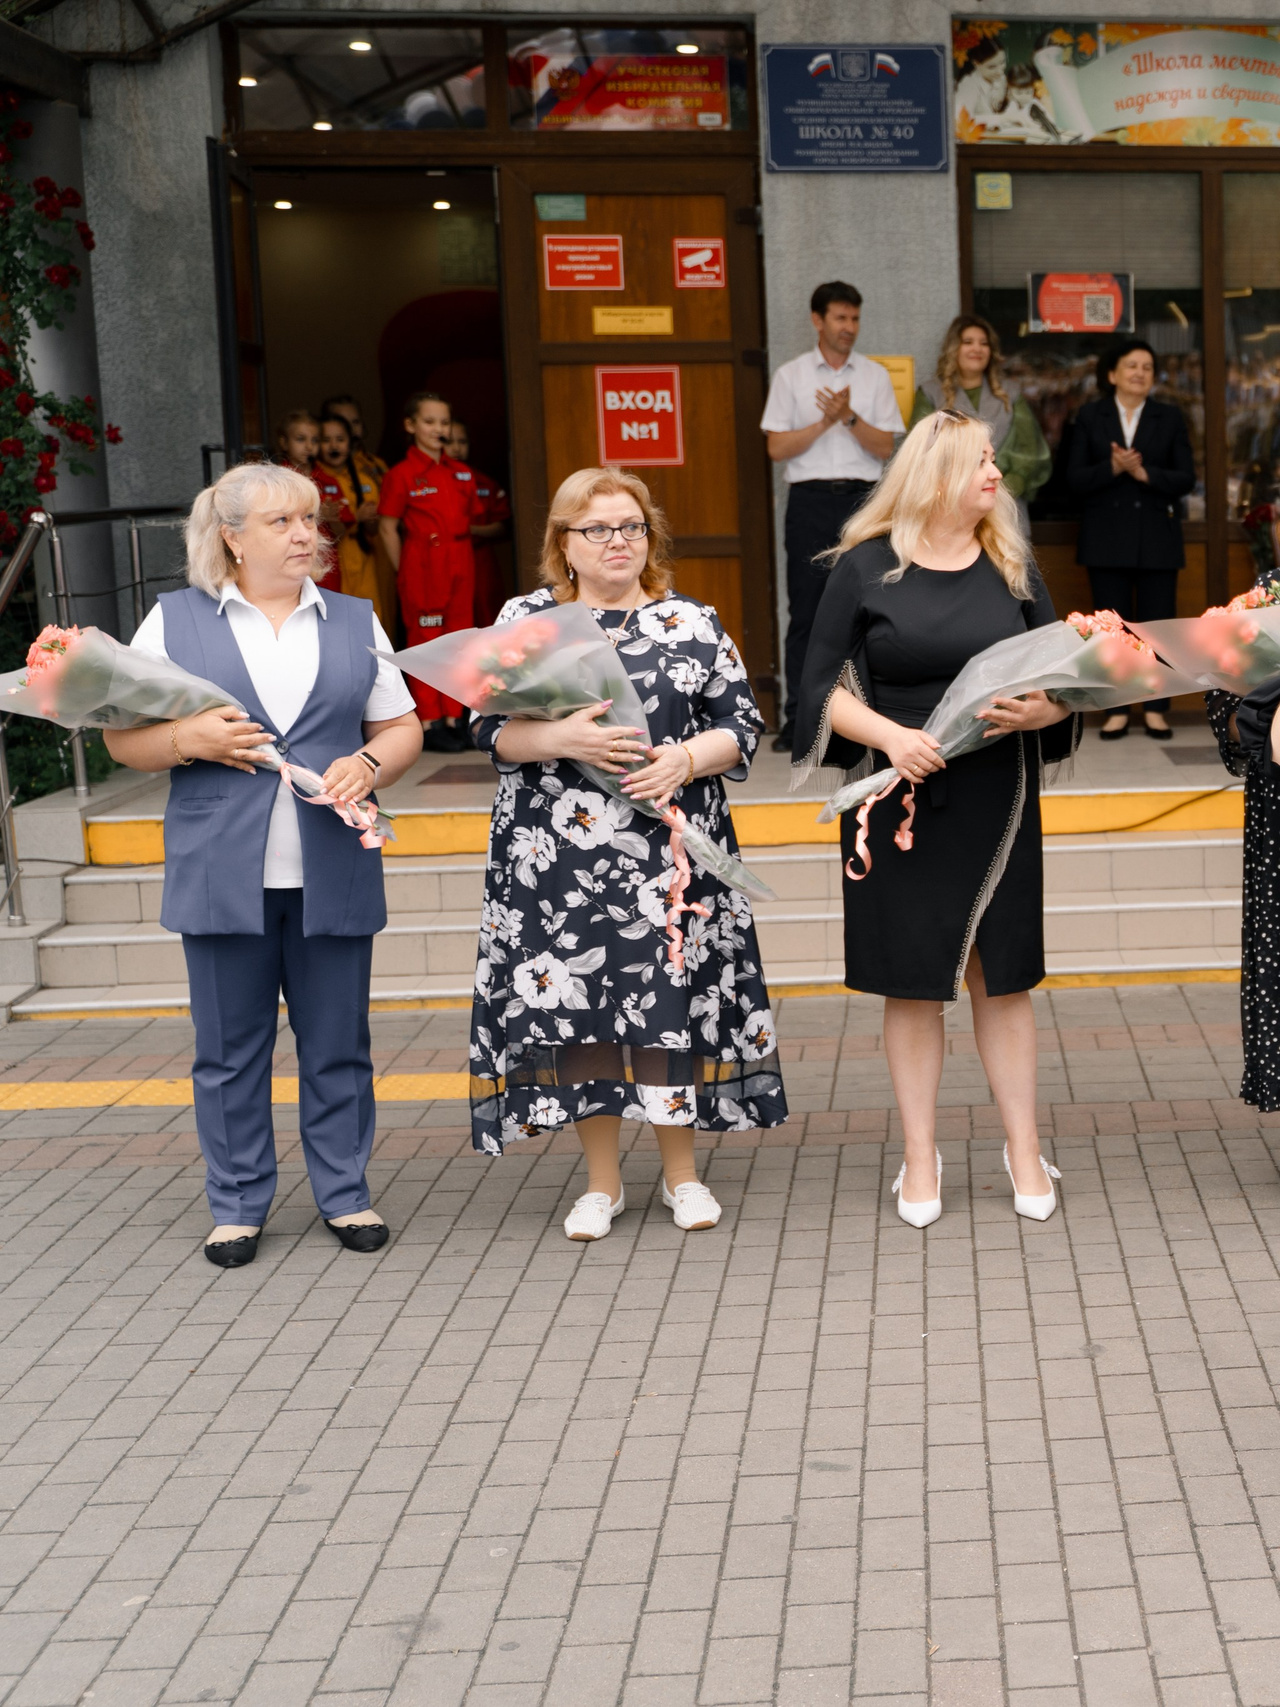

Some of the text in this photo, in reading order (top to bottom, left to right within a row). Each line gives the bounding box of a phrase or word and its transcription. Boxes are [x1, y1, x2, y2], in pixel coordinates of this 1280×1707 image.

[616, 65, 710, 76] УЧАСТКОВАЯ
[1122, 51, 1203, 76] «Школа
[605, 81, 722, 92] ИЗБИРАТЕЛЬНАЯ
[625, 97, 704, 108] КОМИССИЯ
[1113, 87, 1193, 114] надежды
[1196, 88, 1208, 99] и
[798, 125, 915, 139] ШКОЛА № 40
[604, 390, 674, 413] ВХОД
[620, 420, 660, 441] №1
